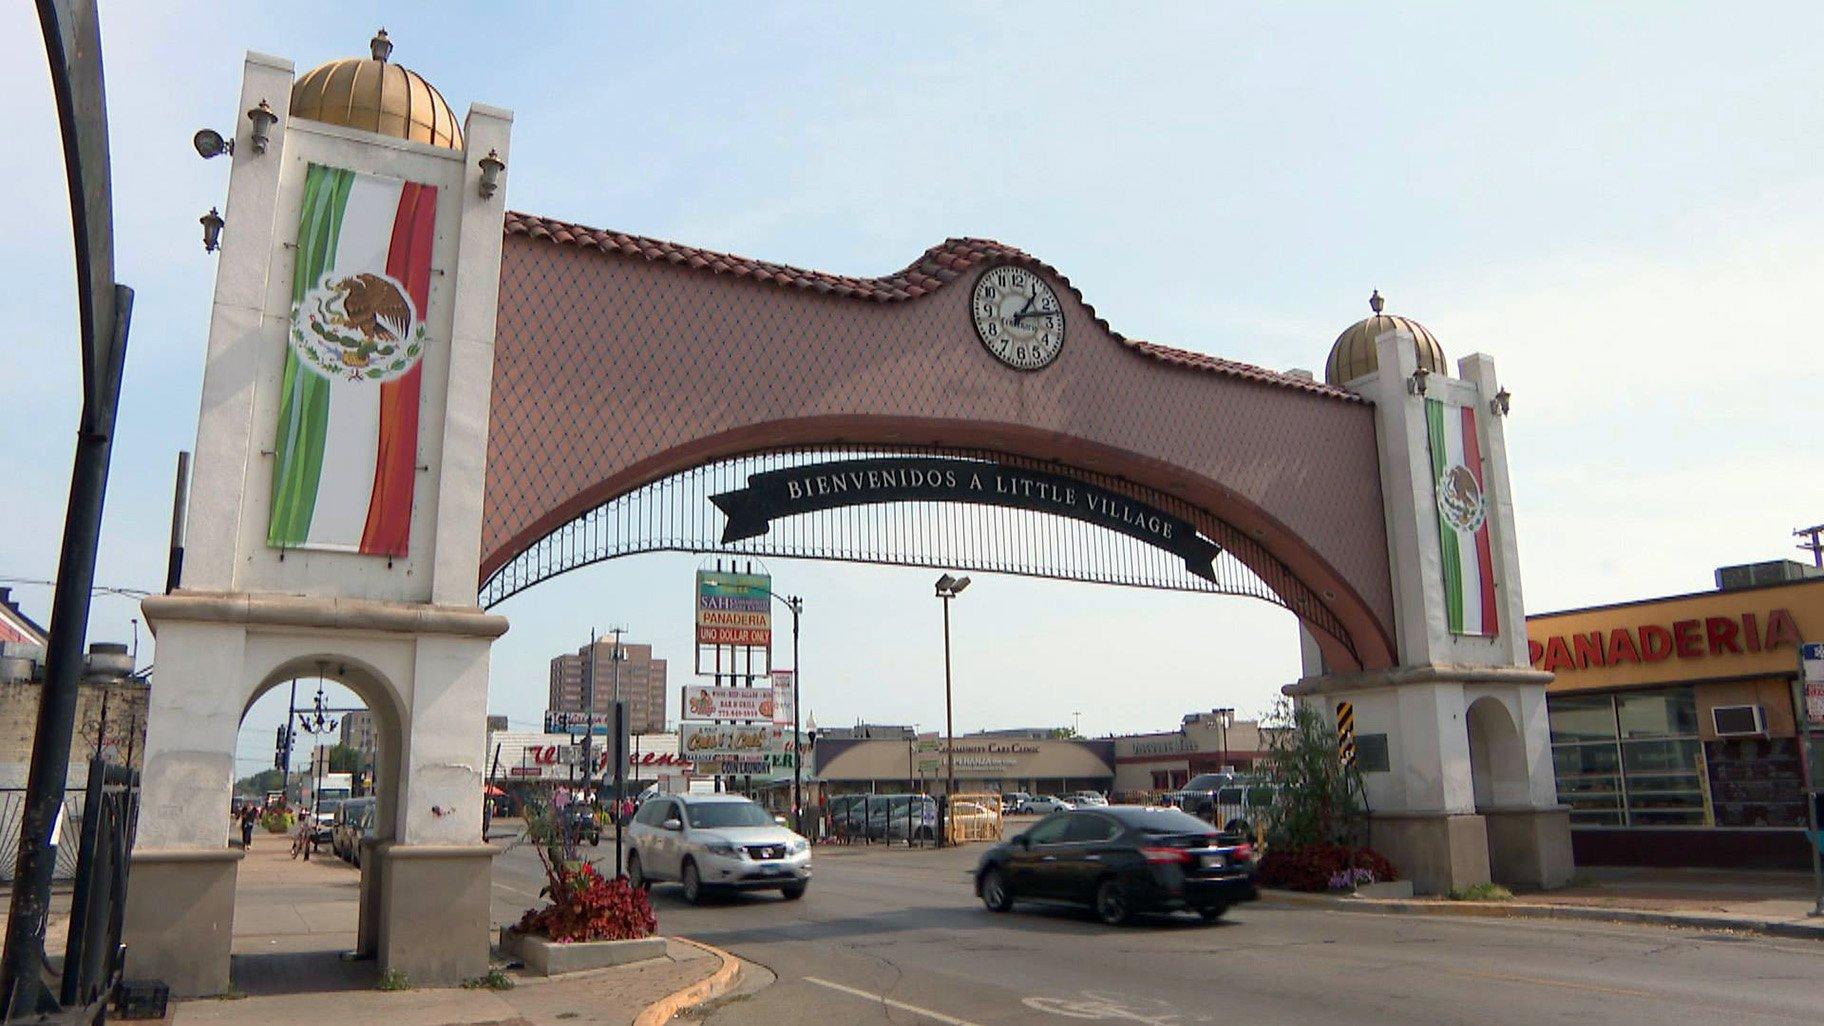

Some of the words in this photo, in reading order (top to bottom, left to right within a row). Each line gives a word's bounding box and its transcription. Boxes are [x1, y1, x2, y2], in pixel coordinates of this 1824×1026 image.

[998, 275, 1006, 288] 11
[1012, 274, 1024, 287] 12
[985, 286, 996, 299] 10
[984, 304, 993, 318] 9
[1042, 298, 1050, 311] 2
[988, 323, 997, 336] 8
[1045, 316, 1054, 330] 3
[1000, 339, 1010, 352] 7
[1041, 333, 1049, 346] 4
[1016, 346, 1026, 360] 6
[1032, 346, 1041, 359] 5
[787, 469, 957, 501] BIENVENIDOS
[969, 473, 984, 490] A
[996, 475, 1077, 507] LITTLE
[1086, 493, 1175, 540] VILLAGE
[703, 612, 768, 626] PANADERIA
[700, 628, 717, 641] UNO
[720, 629, 749, 643] DOLLAR
[752, 631, 770, 644] ONLY
[1528, 608, 1802, 672] PANADERIA
[740, 762, 770, 775] LAUNDRY
